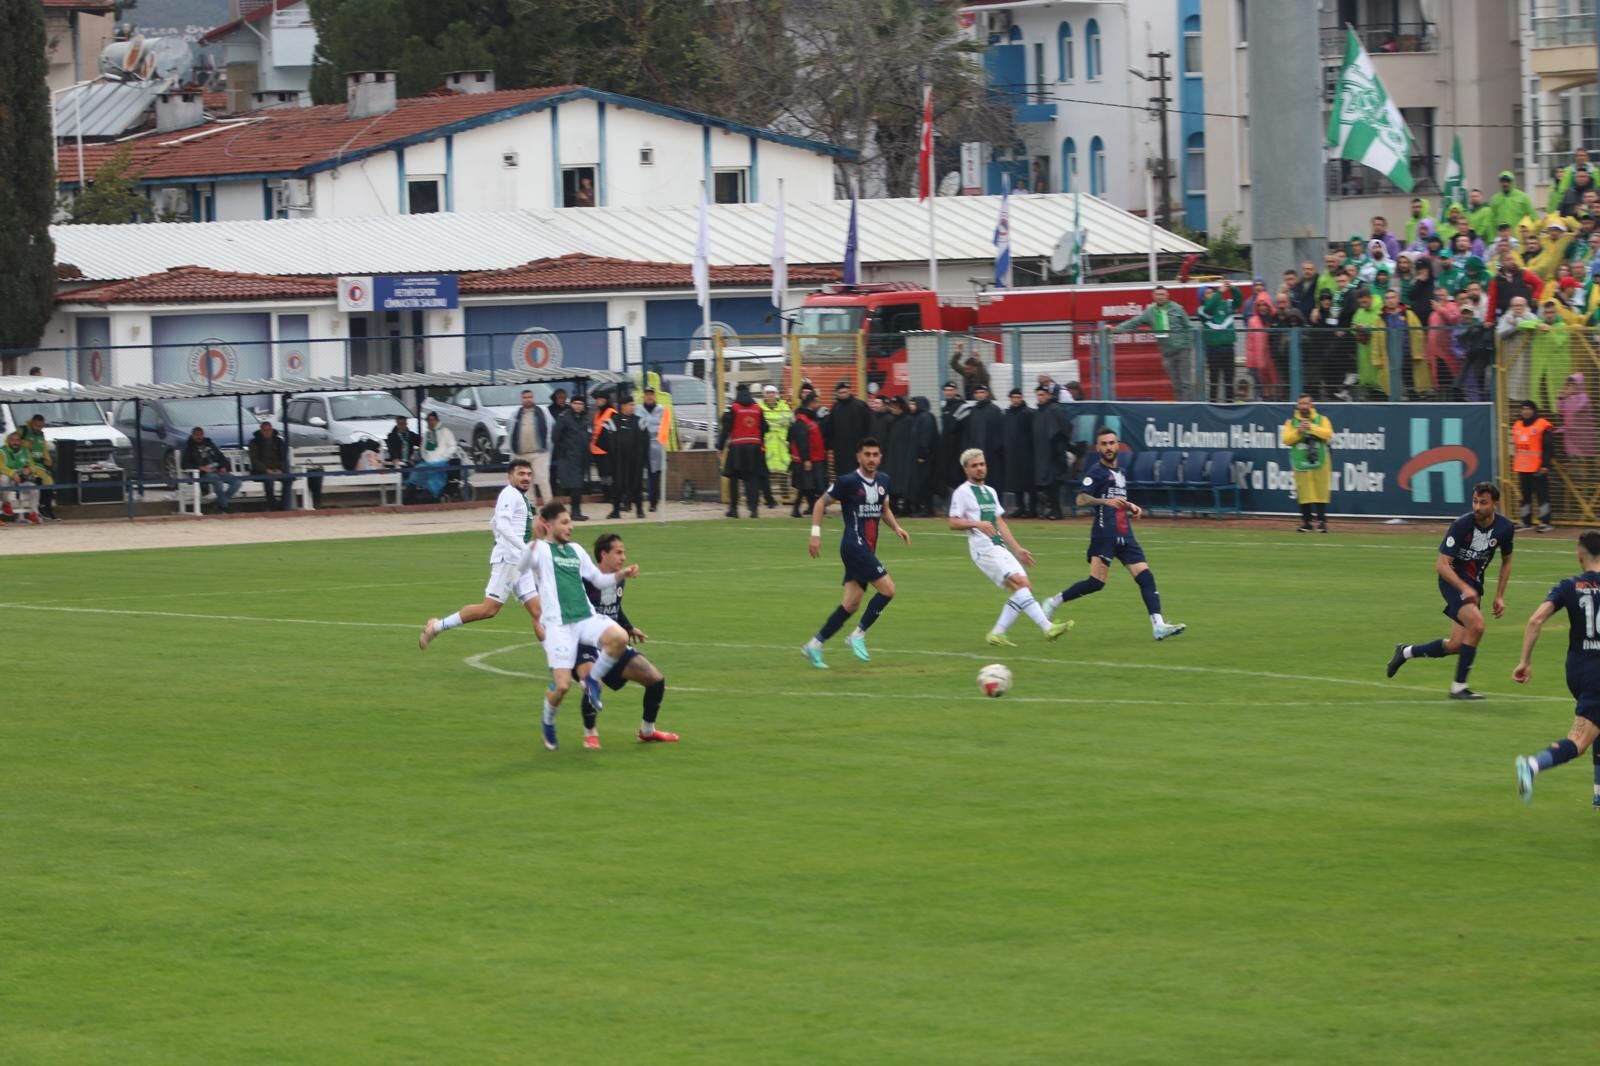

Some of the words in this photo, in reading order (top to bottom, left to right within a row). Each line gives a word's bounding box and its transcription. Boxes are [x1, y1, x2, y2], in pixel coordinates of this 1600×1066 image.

[1144, 417, 1175, 448] Özel
[1176, 423, 1228, 449] Lokman
[1344, 461, 1385, 492] Diler
